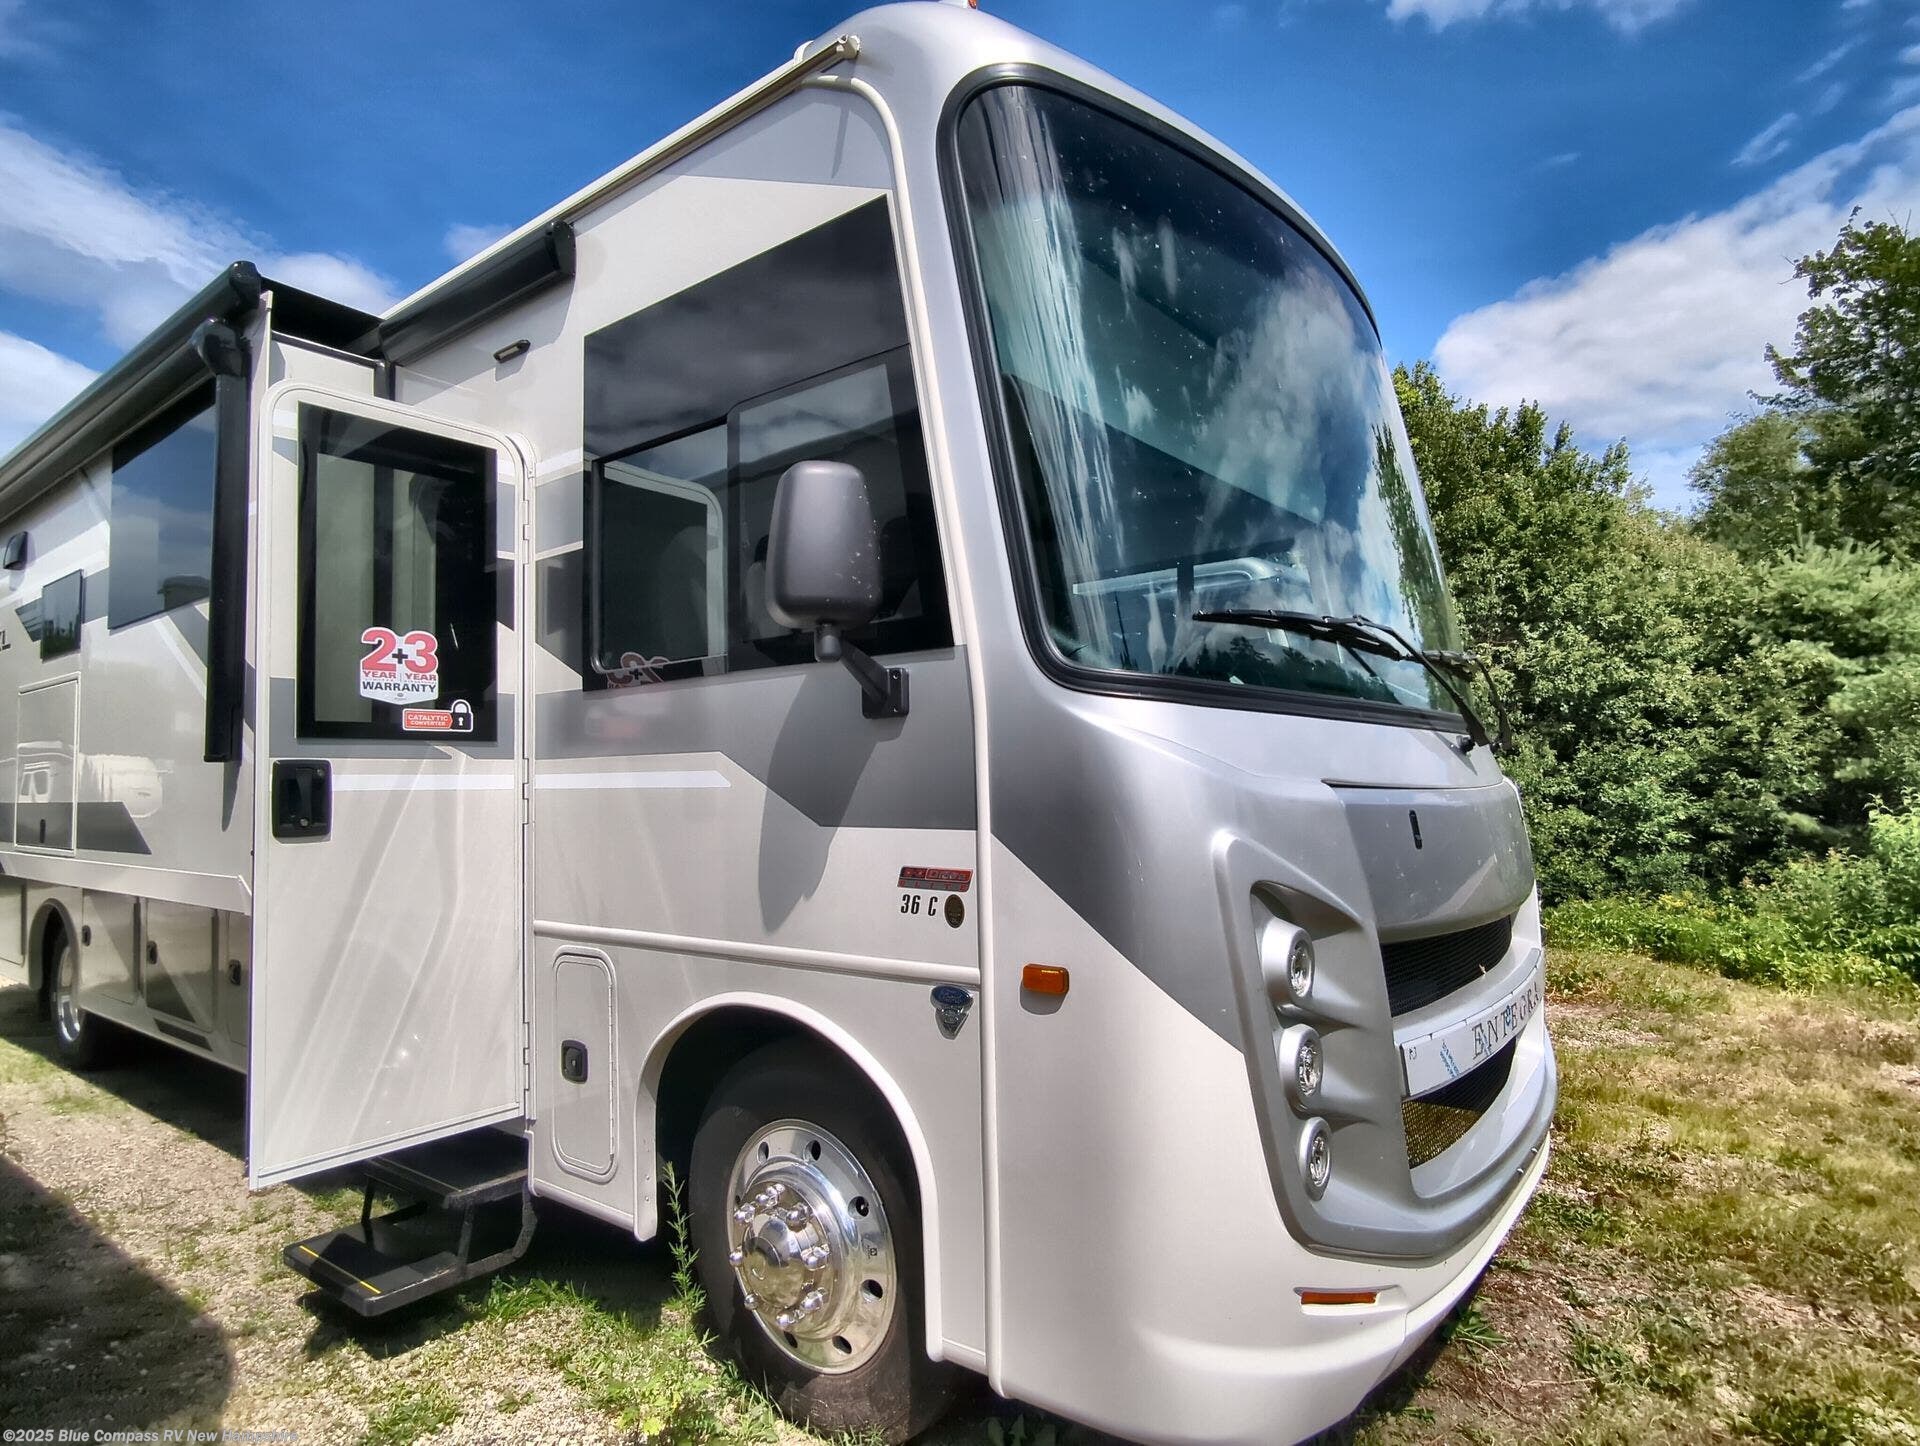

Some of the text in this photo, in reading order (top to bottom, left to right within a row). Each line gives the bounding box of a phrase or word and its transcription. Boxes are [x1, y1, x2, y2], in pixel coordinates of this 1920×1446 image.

[363, 670, 437, 681] YEAR YEAR
[362, 681, 436, 693] WARRANTY
[900, 894, 921, 914] 36
[928, 896, 938, 916] C
